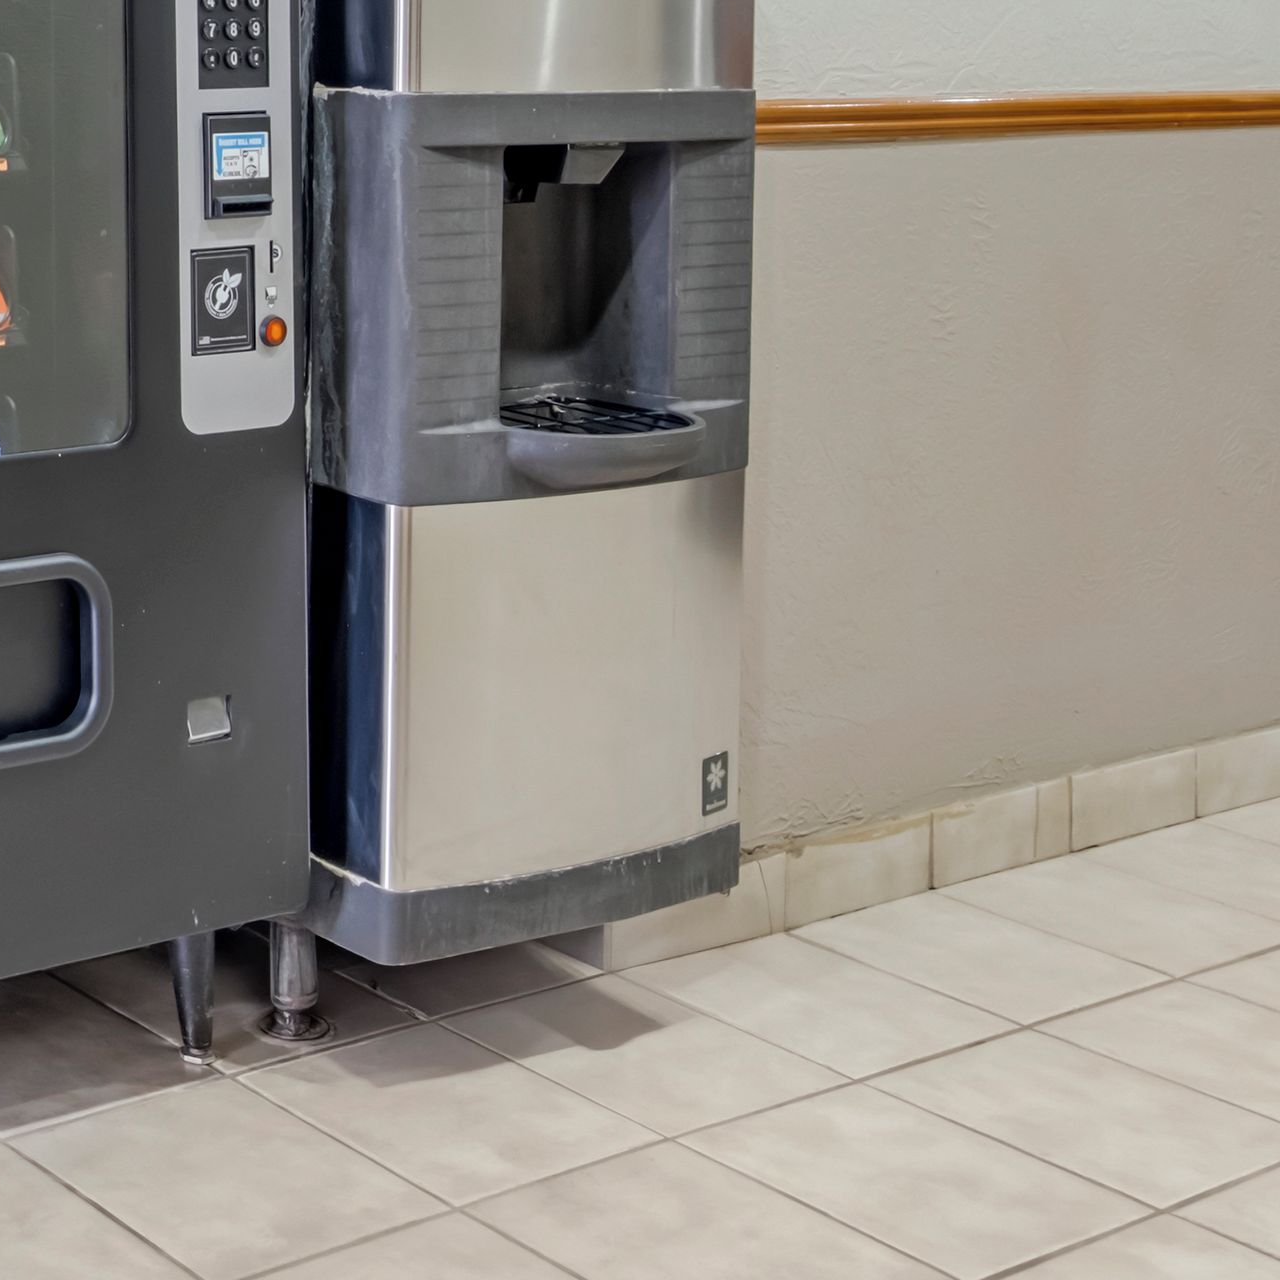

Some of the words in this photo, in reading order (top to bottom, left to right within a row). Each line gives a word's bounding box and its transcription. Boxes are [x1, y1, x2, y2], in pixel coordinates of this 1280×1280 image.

[209, 23, 216, 37] 7
[230, 22, 237, 37] 8
[252, 21, 260, 36] 9
[230, 51, 237, 65] 0
